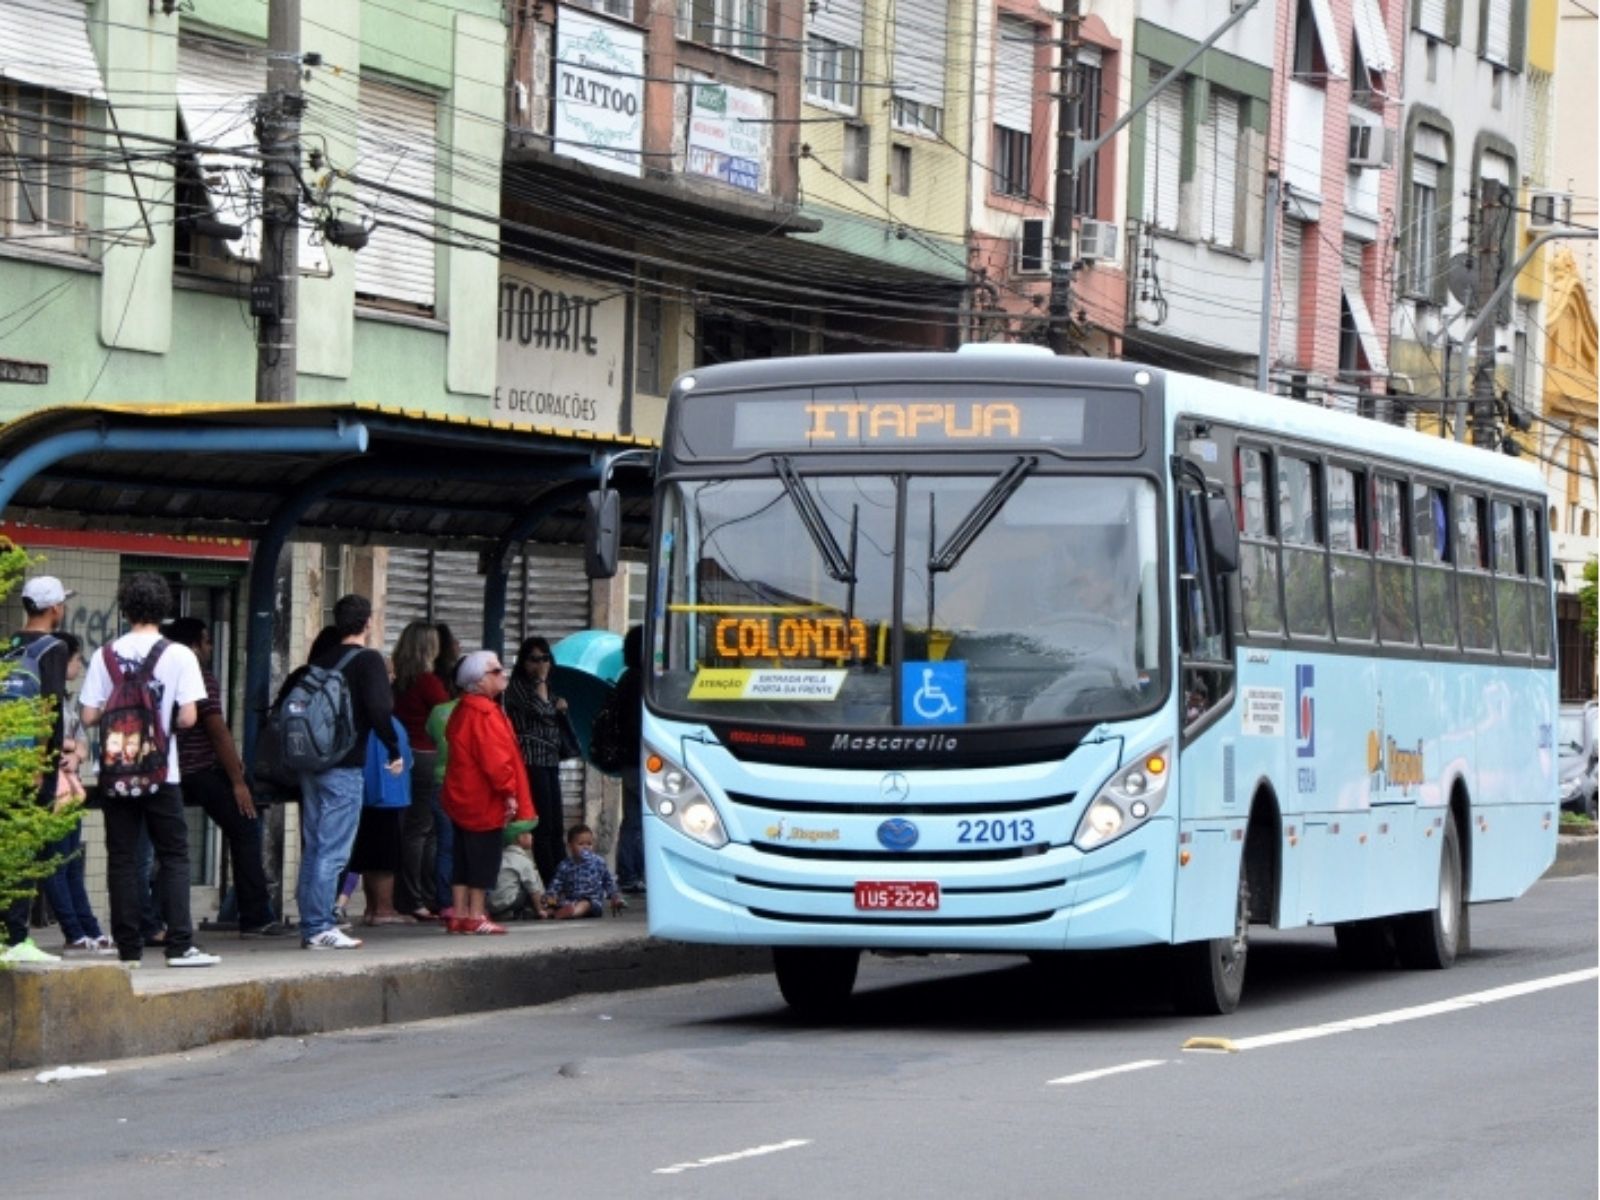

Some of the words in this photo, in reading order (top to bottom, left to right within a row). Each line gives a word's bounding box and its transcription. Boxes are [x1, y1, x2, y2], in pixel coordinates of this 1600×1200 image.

[563, 72, 637, 117] TATTOO
[509, 388, 597, 421] DECORAÇÕES
[805, 403, 1019, 438] ITAPUA
[716, 618, 867, 657] COLONIA
[698, 677, 743, 690] ATENÇÃO
[957, 819, 1035, 844] 22013
[860, 890, 937, 907] IUS-2224
